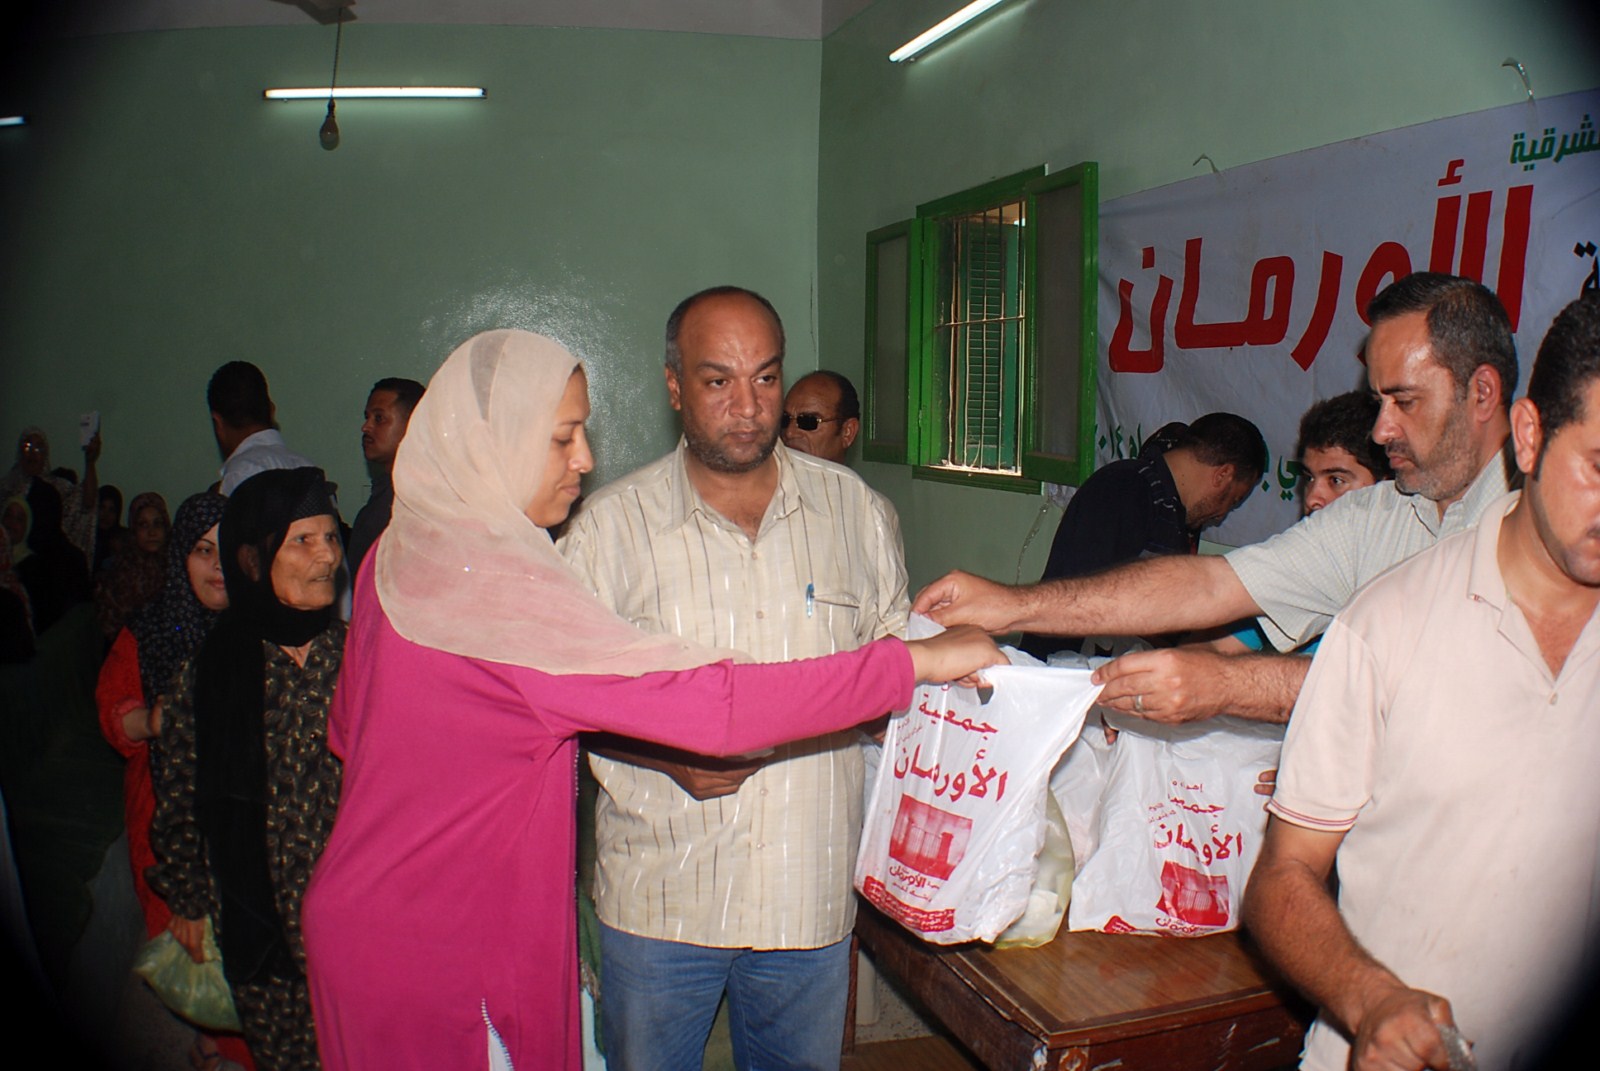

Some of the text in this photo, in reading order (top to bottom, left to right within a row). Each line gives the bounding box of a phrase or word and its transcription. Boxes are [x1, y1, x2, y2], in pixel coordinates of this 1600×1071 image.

[1510, 114, 1600, 171] شرقية
[918, 692, 998, 740] جمعية
[894, 745, 1008, 802] الأورمان
